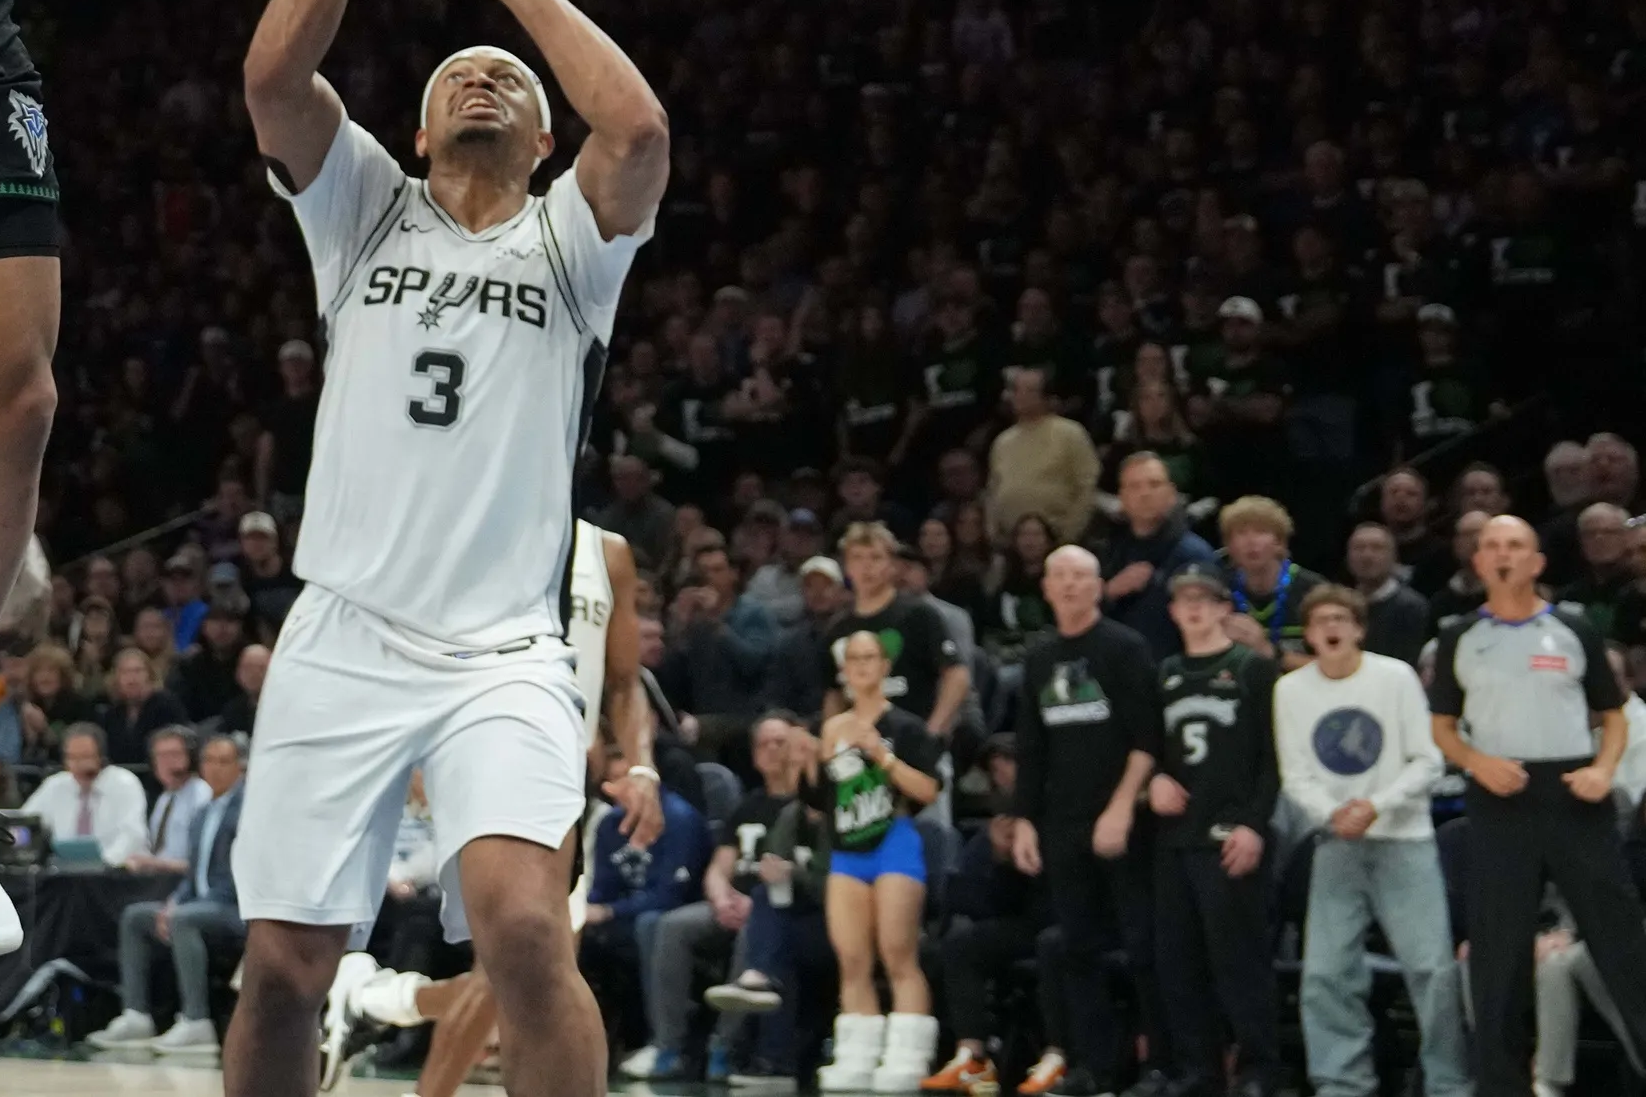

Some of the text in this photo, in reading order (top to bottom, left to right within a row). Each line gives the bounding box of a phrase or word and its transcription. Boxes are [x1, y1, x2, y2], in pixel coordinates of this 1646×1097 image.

[364, 266, 547, 330] SPURS
[407, 346, 469, 432] 3
[1182, 720, 1209, 767] 5
